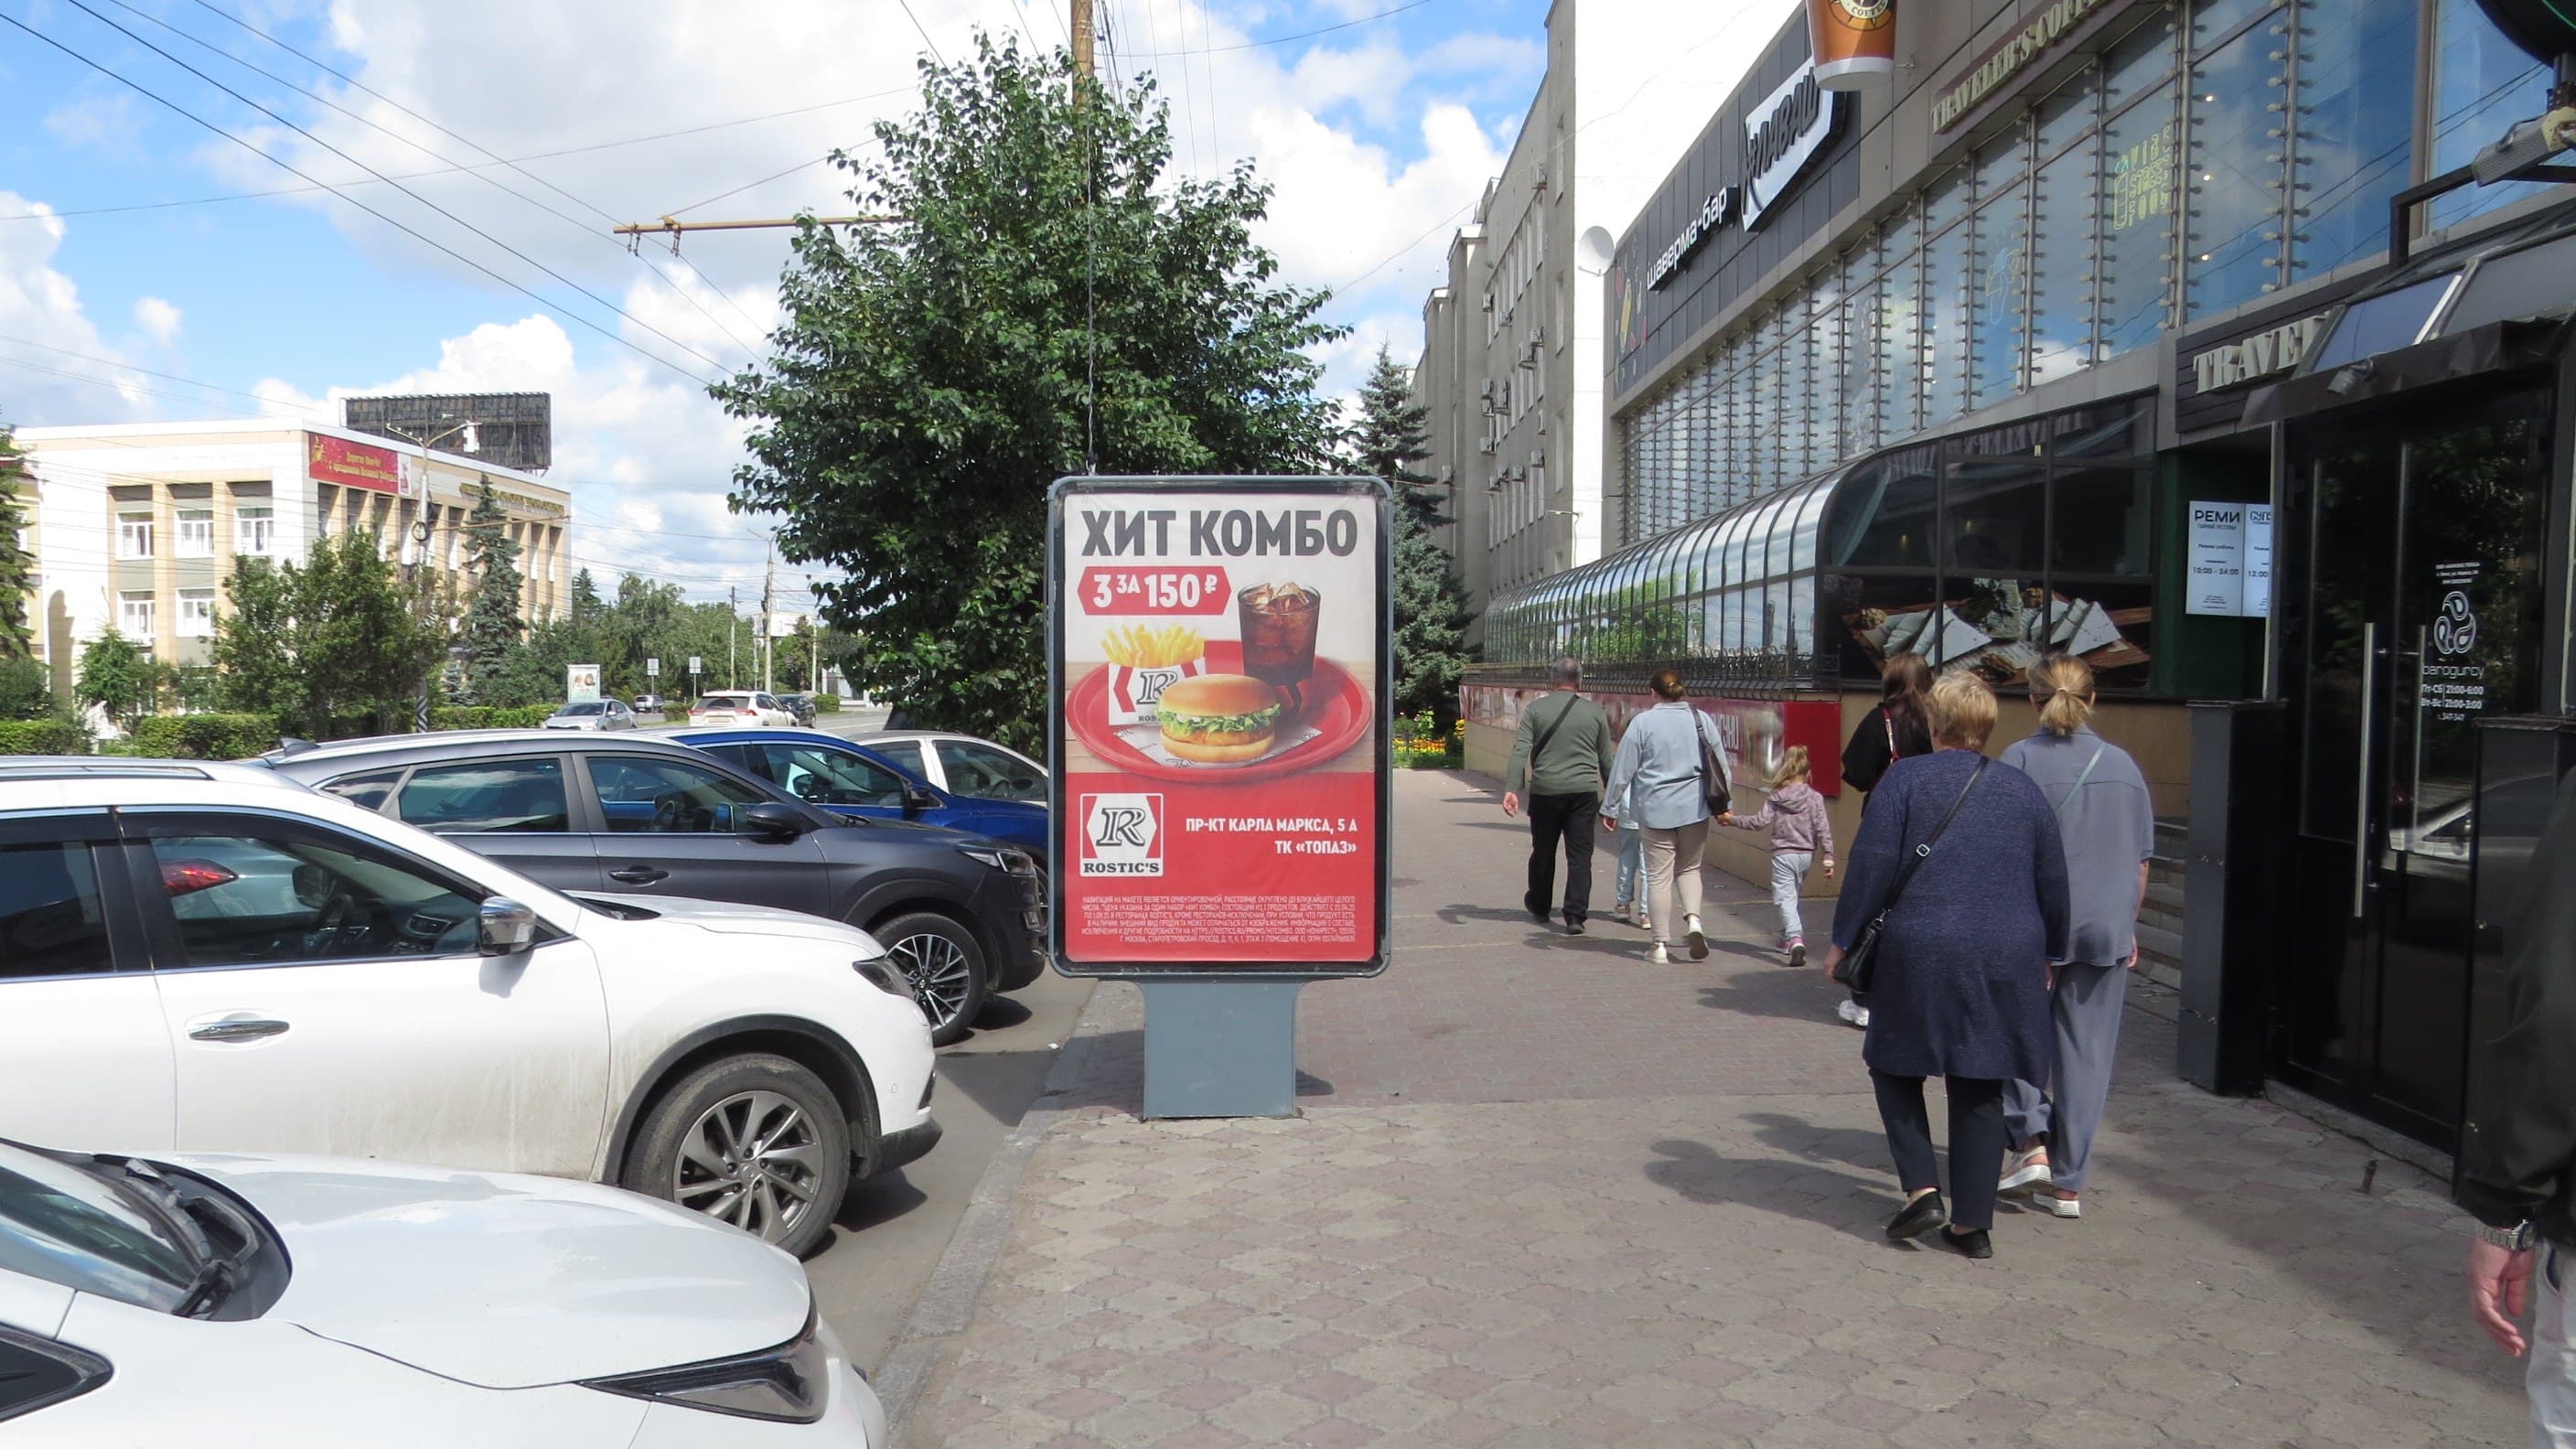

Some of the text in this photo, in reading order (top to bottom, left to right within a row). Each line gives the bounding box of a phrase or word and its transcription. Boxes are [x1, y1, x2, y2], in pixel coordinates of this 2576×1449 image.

[2036, 0, 2104, 48] COFF
[1647, 187, 1727, 291] шаверма-бар
[2195, 510, 2240, 523] РЕМИ
[1081, 510, 1358, 556] ХИТ КОМБО
[1093, 574, 1112, 608] 3
[1186, 818, 1358, 835] ПР-КТ КАРЛА МАРКСА, 5 А
[1274, 841, 1358, 854] ТК «ТОПАЗ»
[1083, 863, 1160, 874] ROSTIC'S
